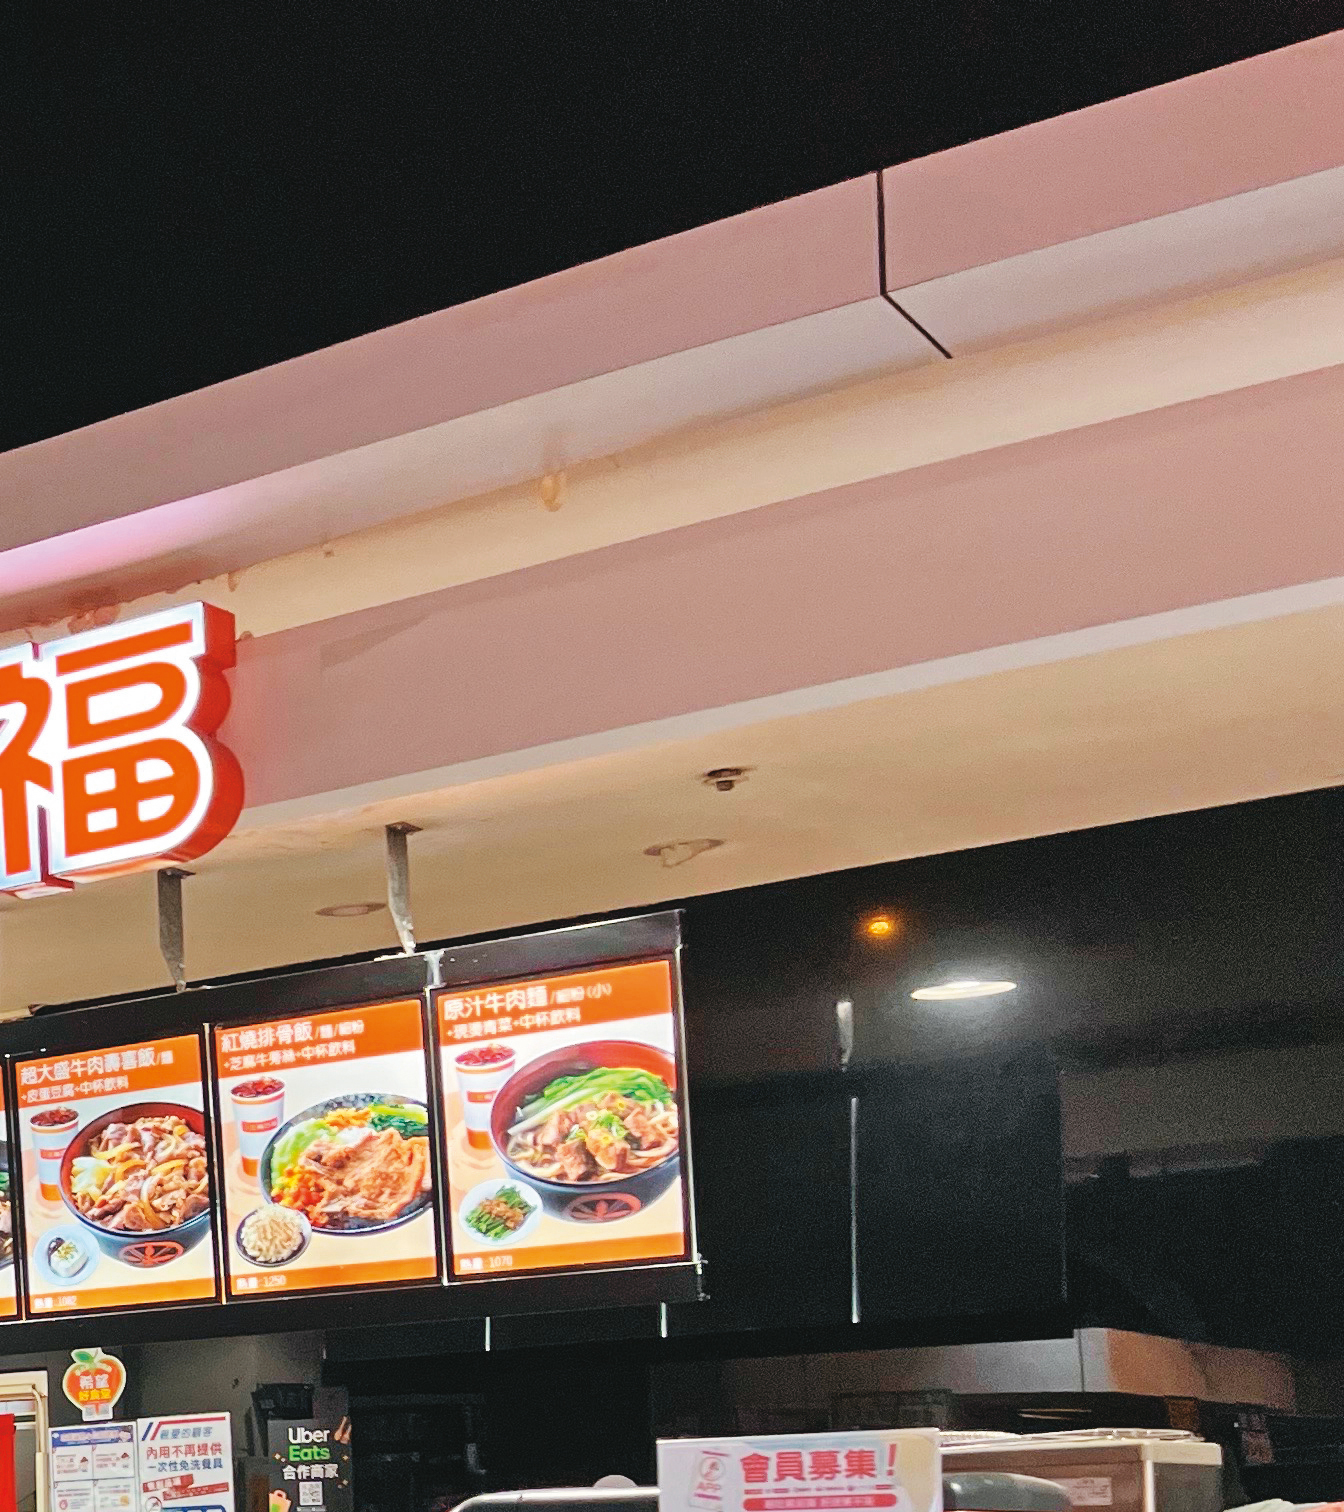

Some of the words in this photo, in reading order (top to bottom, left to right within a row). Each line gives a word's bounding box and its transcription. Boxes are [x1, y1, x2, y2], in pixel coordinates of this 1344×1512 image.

[288, 1426, 330, 1444] Uber
[288, 1445, 330, 1462] Eats
[282, 1464, 339, 1480] 合作商家
